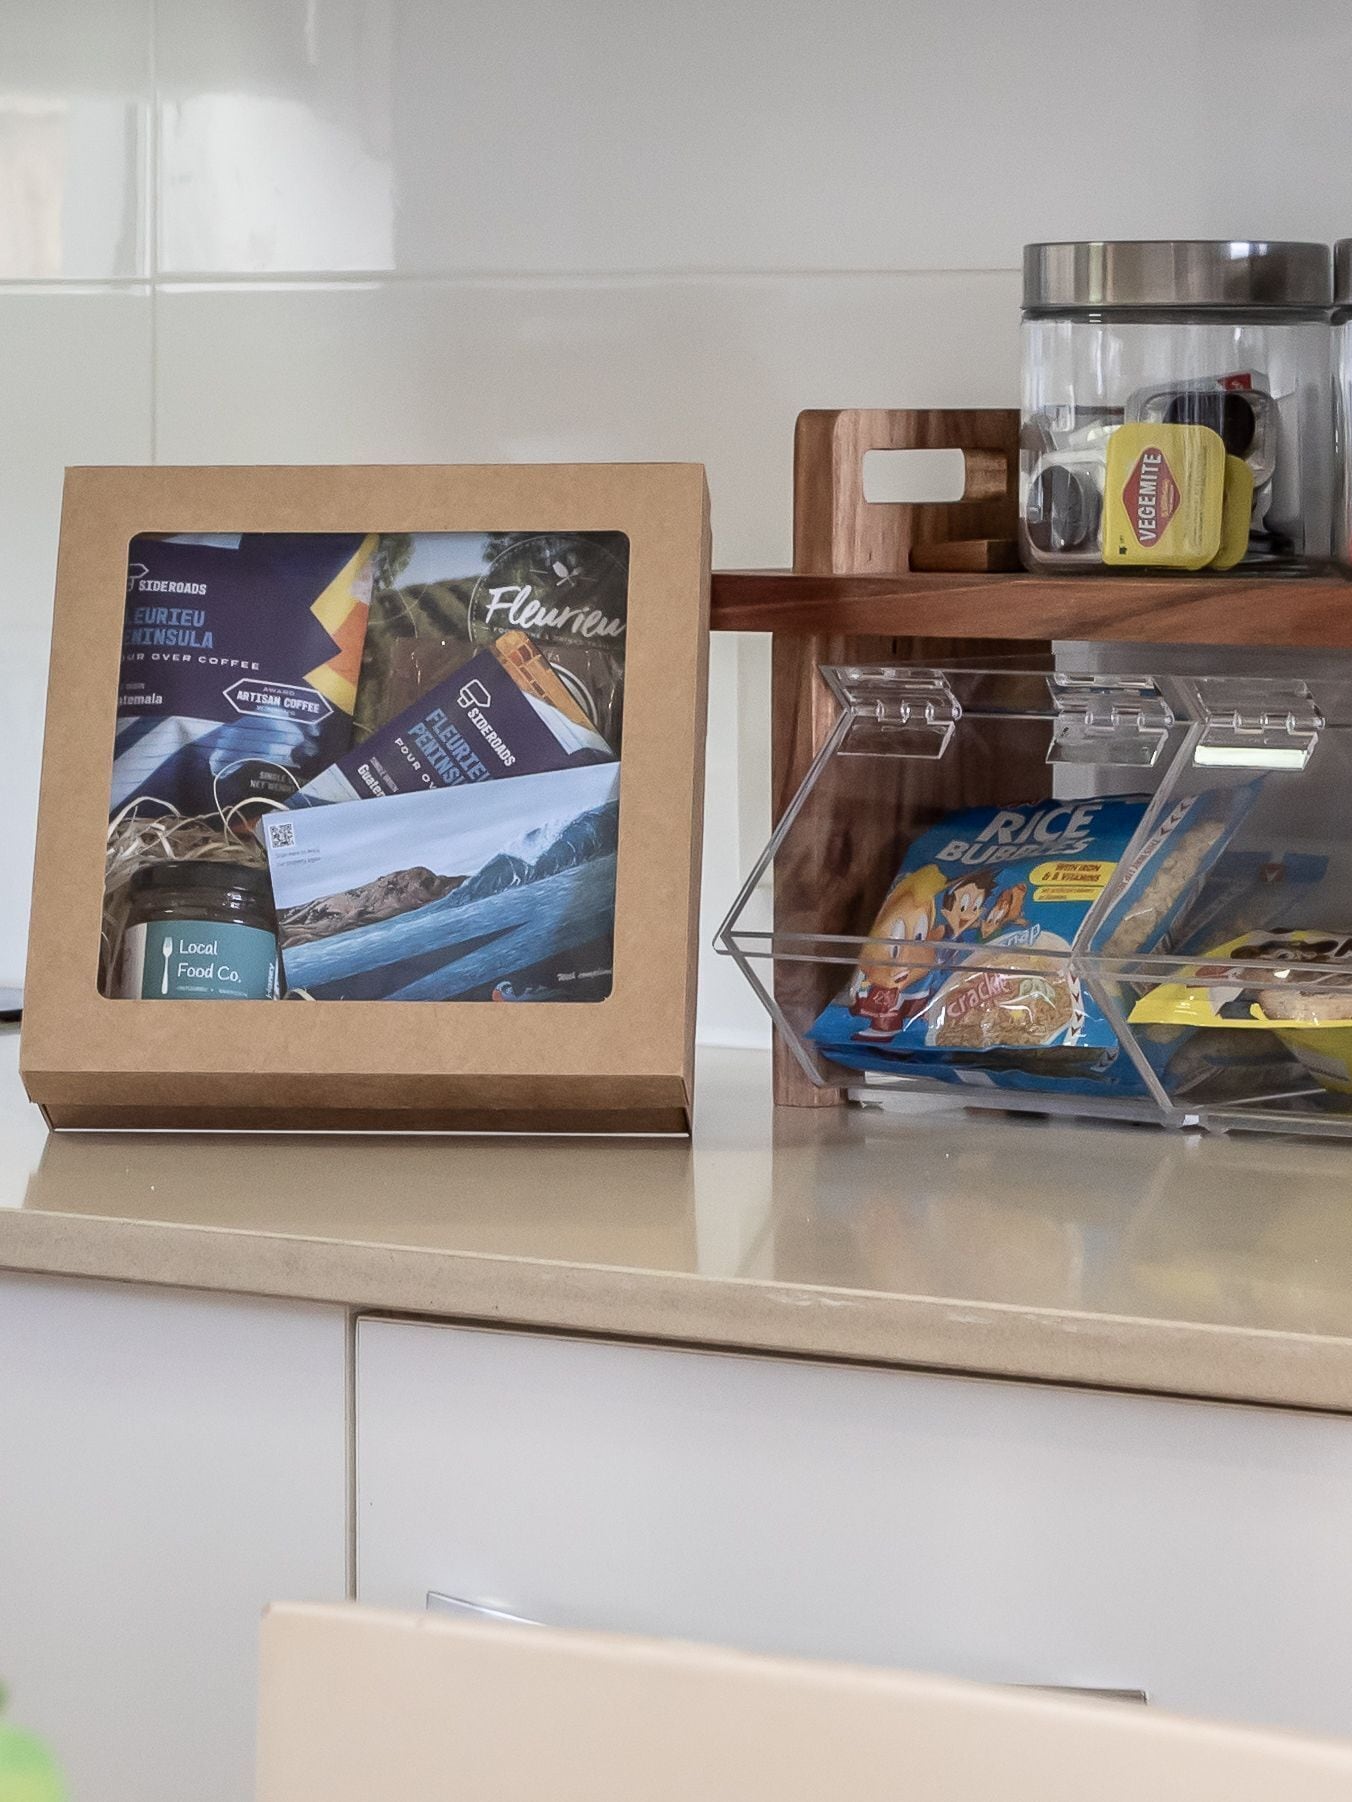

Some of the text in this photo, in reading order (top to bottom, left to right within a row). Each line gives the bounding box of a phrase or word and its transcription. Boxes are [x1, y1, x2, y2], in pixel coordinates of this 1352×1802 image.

[1137, 453, 1161, 541] VEGEMITE
[138, 579, 207, 595] SIDEROADS
[126, 606, 205, 627] EURIEU
[485, 585, 625, 638] Fleurieu
[151, 653, 191, 662] OVER
[198, 656, 260, 670] COFFEE
[236, 690, 280, 706] ARTISAN
[283, 697, 320, 713] COFFEE
[467, 708, 516, 766] SIDEROADS
[394, 738, 421, 771] POUR
[976, 804, 1102, 845] RICE
[935, 837, 1096, 865] BUBBLES
[1000, 924, 1040, 946] nap
[179, 940, 217, 955] Local
[177, 962, 241, 983] Food Co.
